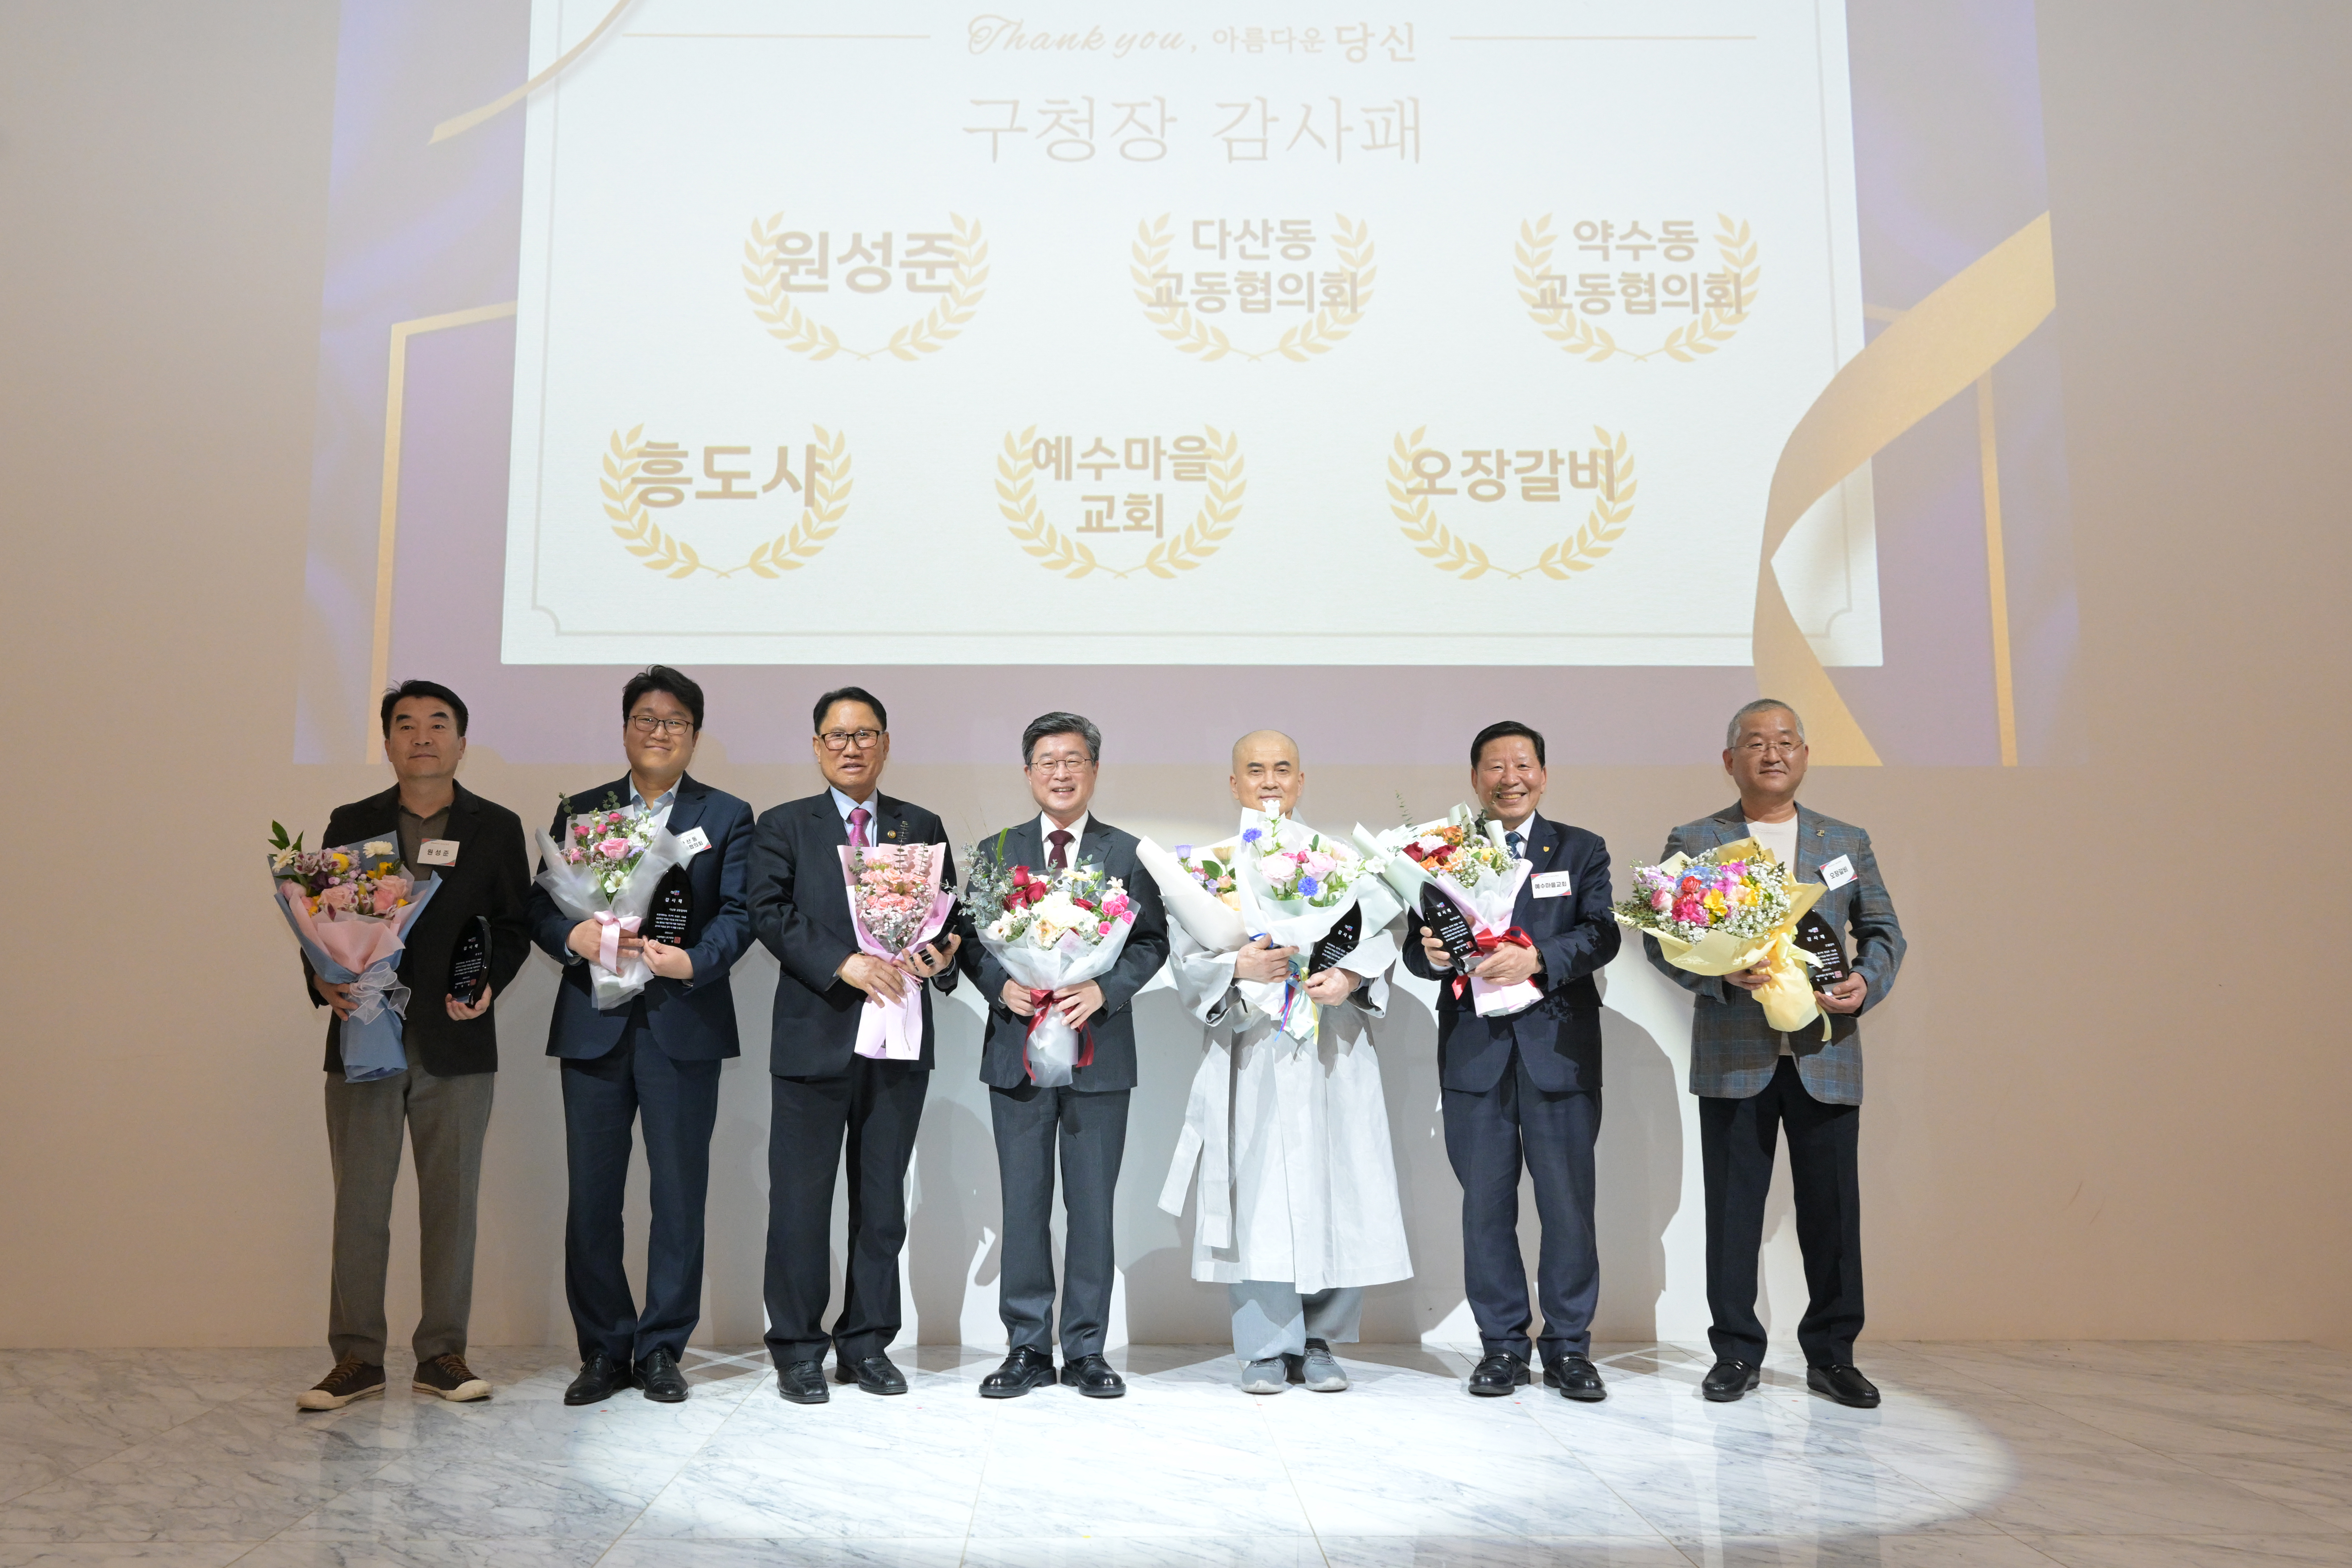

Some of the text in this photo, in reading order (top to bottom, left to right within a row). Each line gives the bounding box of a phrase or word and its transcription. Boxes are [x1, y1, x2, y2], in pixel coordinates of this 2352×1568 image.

[967, 14, 1106, 54] Thank
[1212, 26, 1326, 54] 아름다운
[1334, 22, 1417, 62] 당신
[962, 95, 1422, 164] 구청장 감사패
[773, 230, 959, 294] 원성준
[1192, 218, 1316, 261] 다산동
[1573, 220, 1699, 262] 약수동
[1147, 270, 1358, 313] 교동협의회
[1532, 272, 1743, 315] 교동협의회
[630, 440, 824, 508] 흥도사
[1032, 435, 1212, 482] 예수마을
[1406, 449, 1616, 502] 오장갈비
[1076, 493, 1164, 539] 교회
[1830, 866, 1848, 879] 오장갈비
